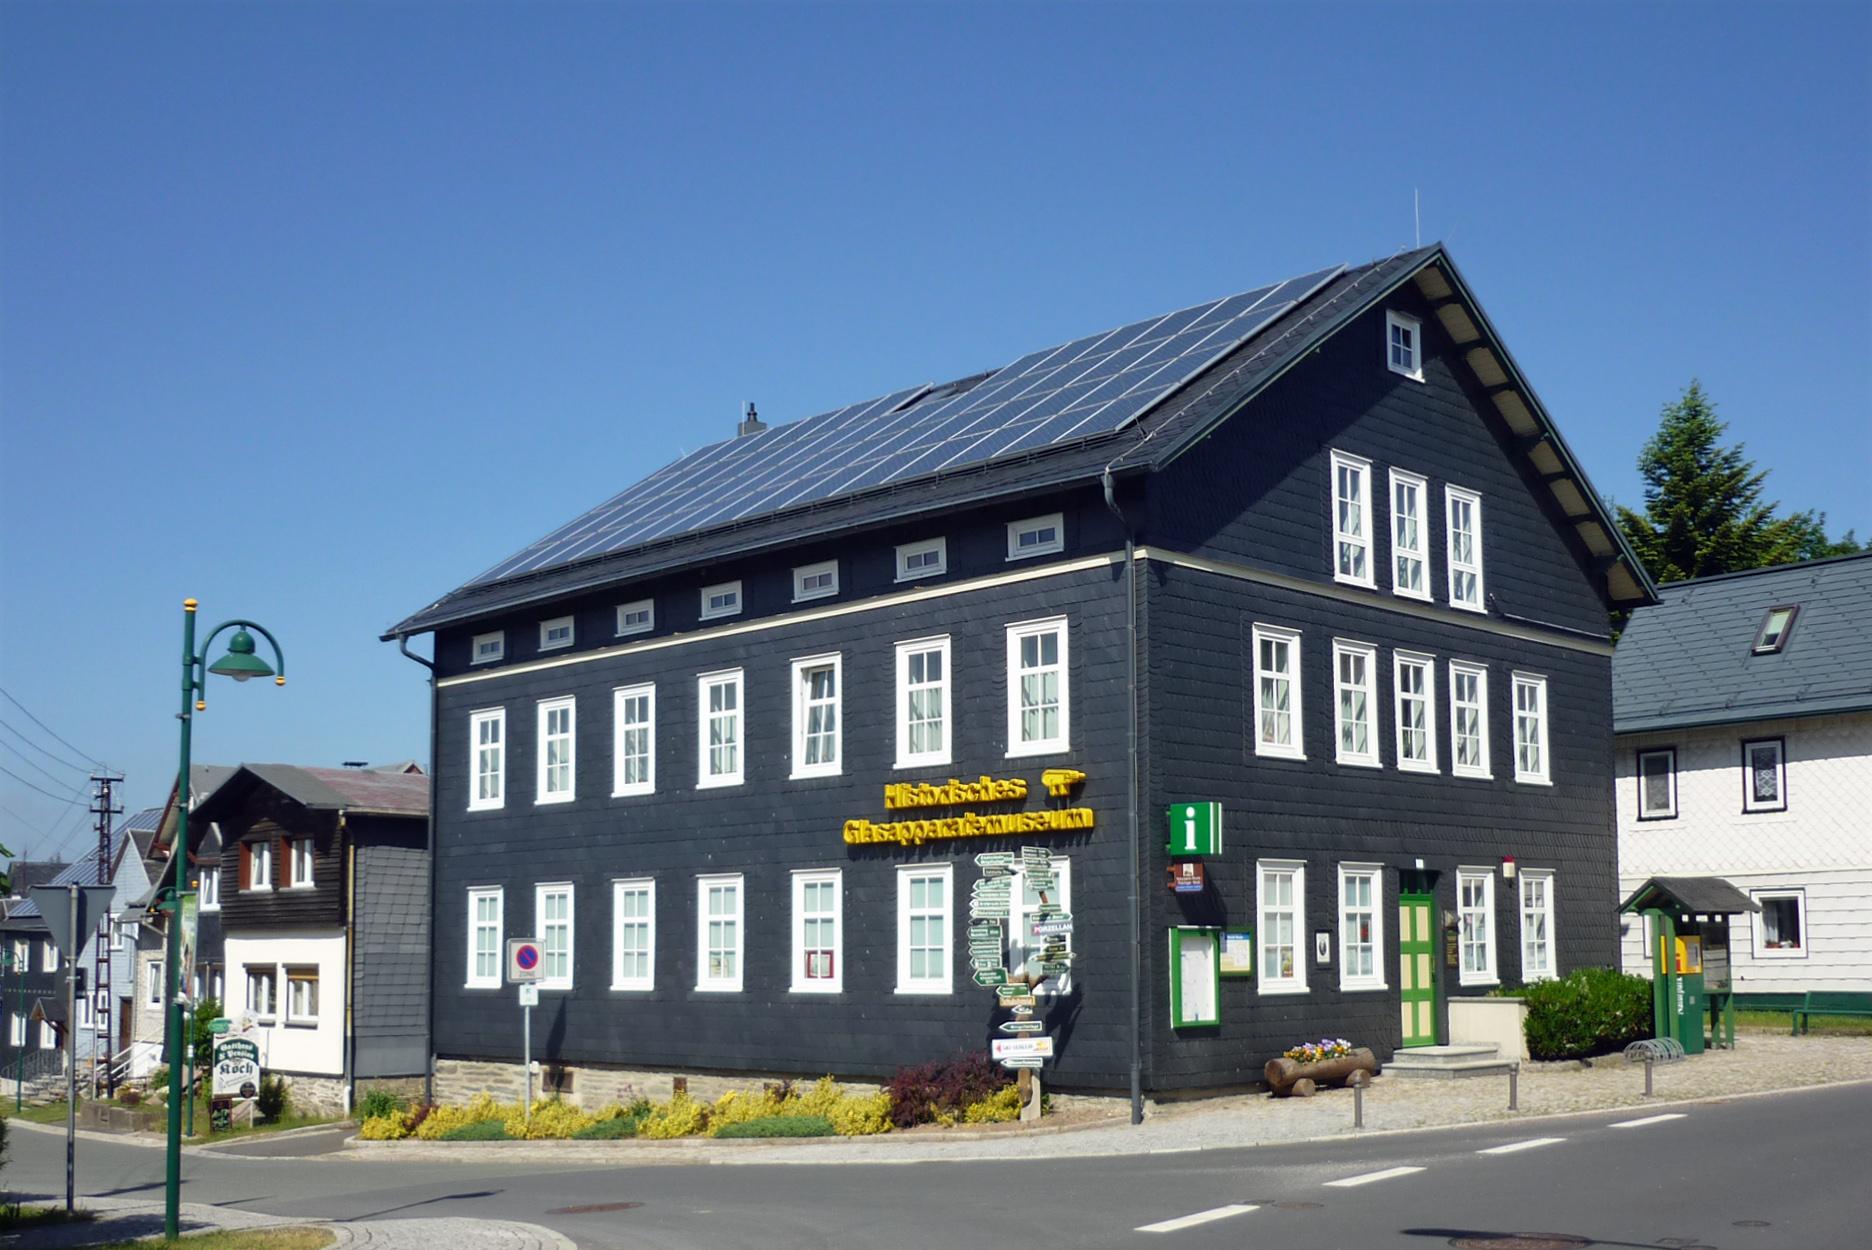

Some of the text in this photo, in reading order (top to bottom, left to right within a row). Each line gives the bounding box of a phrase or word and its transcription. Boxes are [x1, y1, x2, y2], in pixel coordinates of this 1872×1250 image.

[884, 776, 1028, 809] Historisches
[843, 808, 1095, 845] Glasapparatemuseum
[1184, 806, 1197, 850] i
[219, 1062, 253, 1075] Koch
